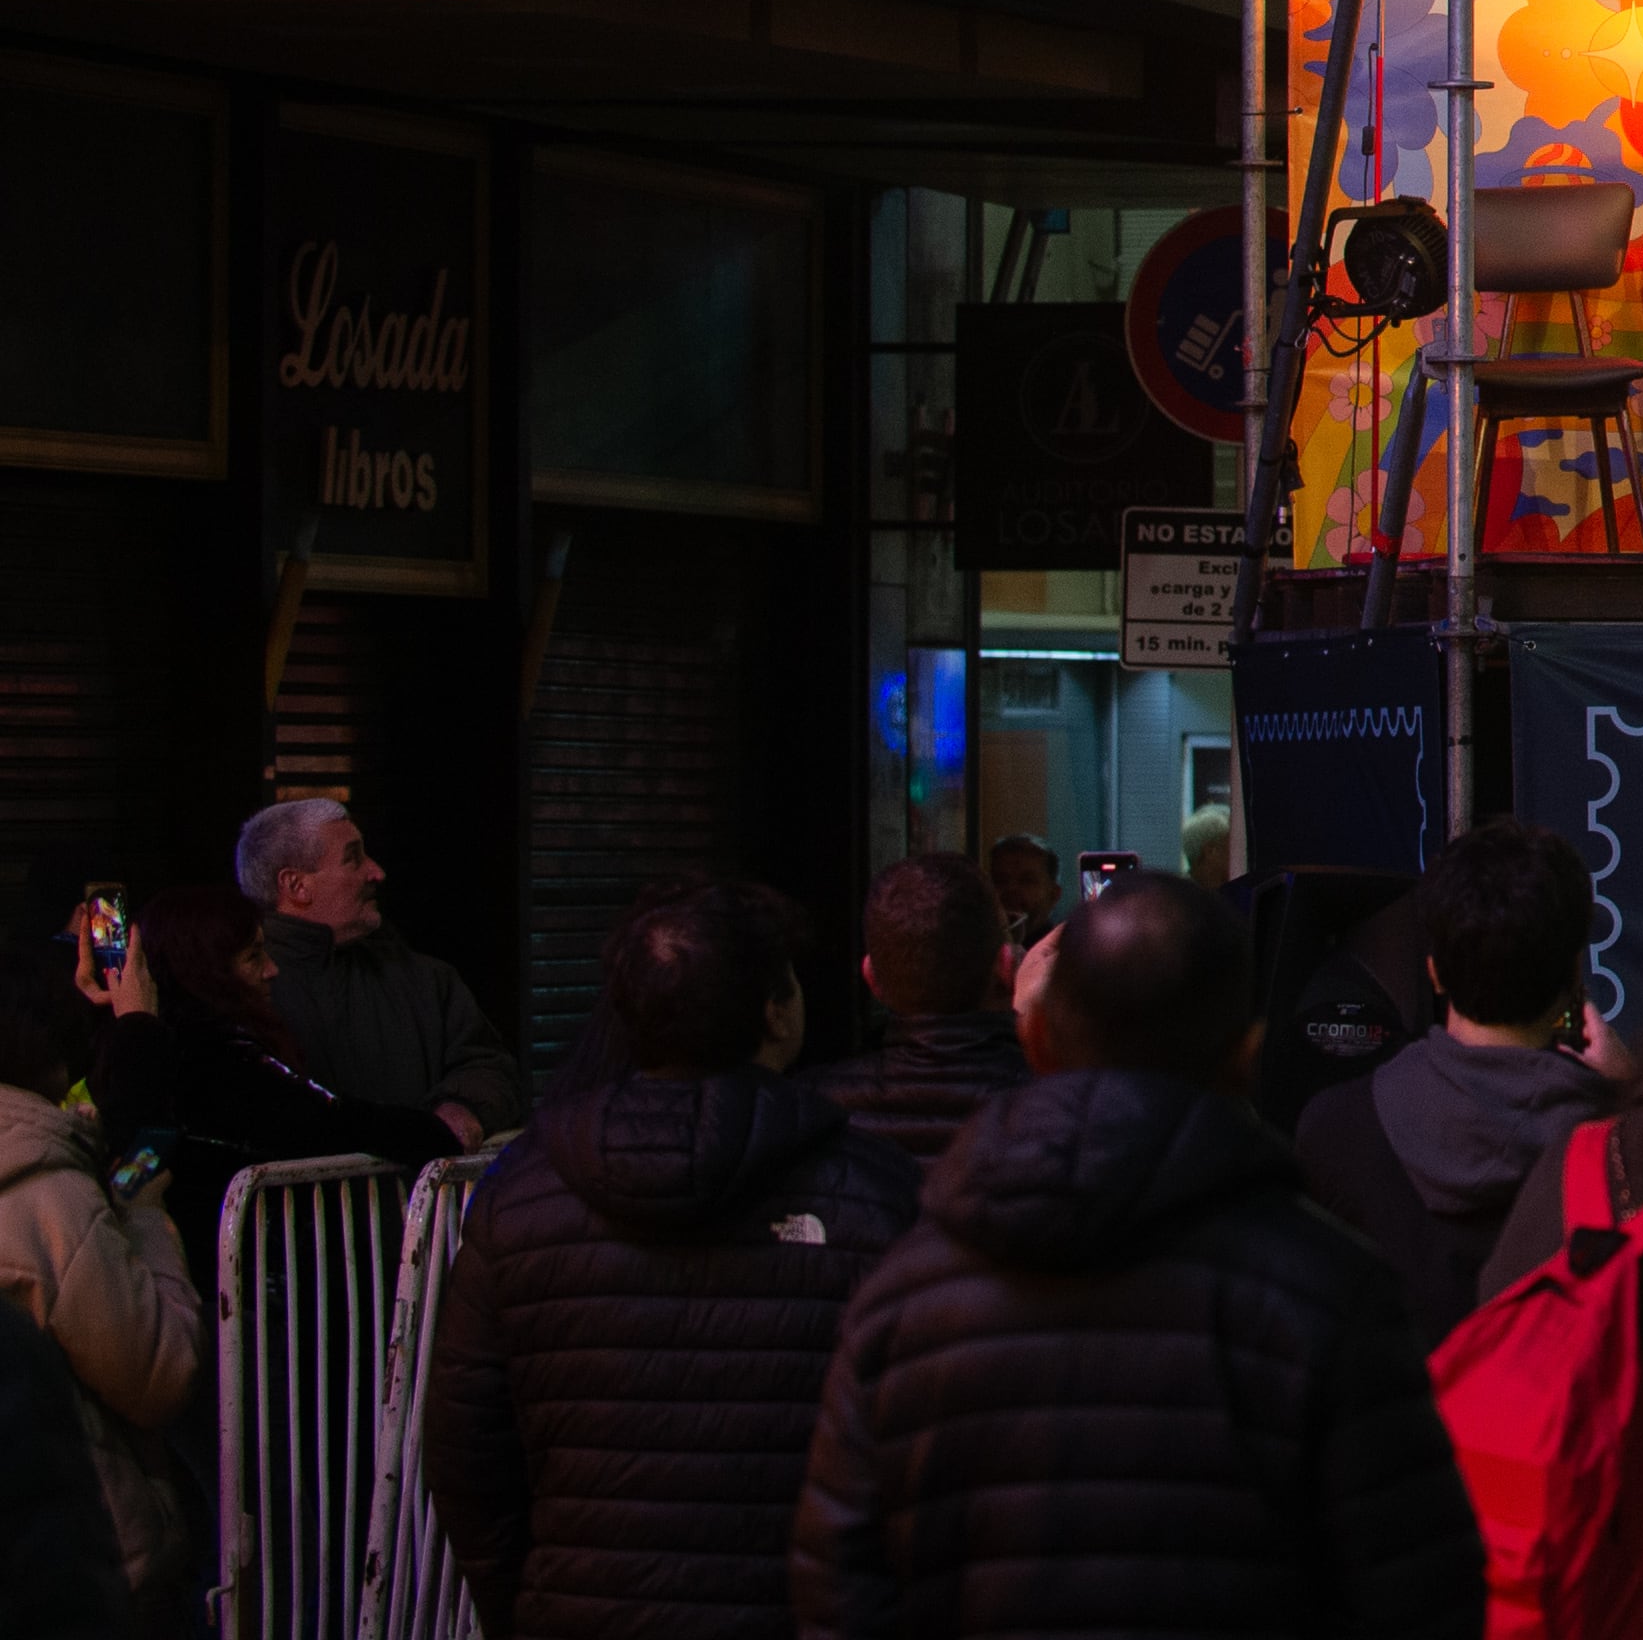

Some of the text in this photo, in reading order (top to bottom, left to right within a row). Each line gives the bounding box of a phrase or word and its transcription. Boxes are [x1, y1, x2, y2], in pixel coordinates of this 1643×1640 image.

[279, 239, 470, 392] Losada
[319, 426, 438, 512] libros
[1137, 522, 1176, 543] NO
[1182, 602, 1205, 616] de
[1211, 603, 1222, 616] 2
[1136, 635, 1160, 651] 15
[1167, 636, 1211, 652] min.
